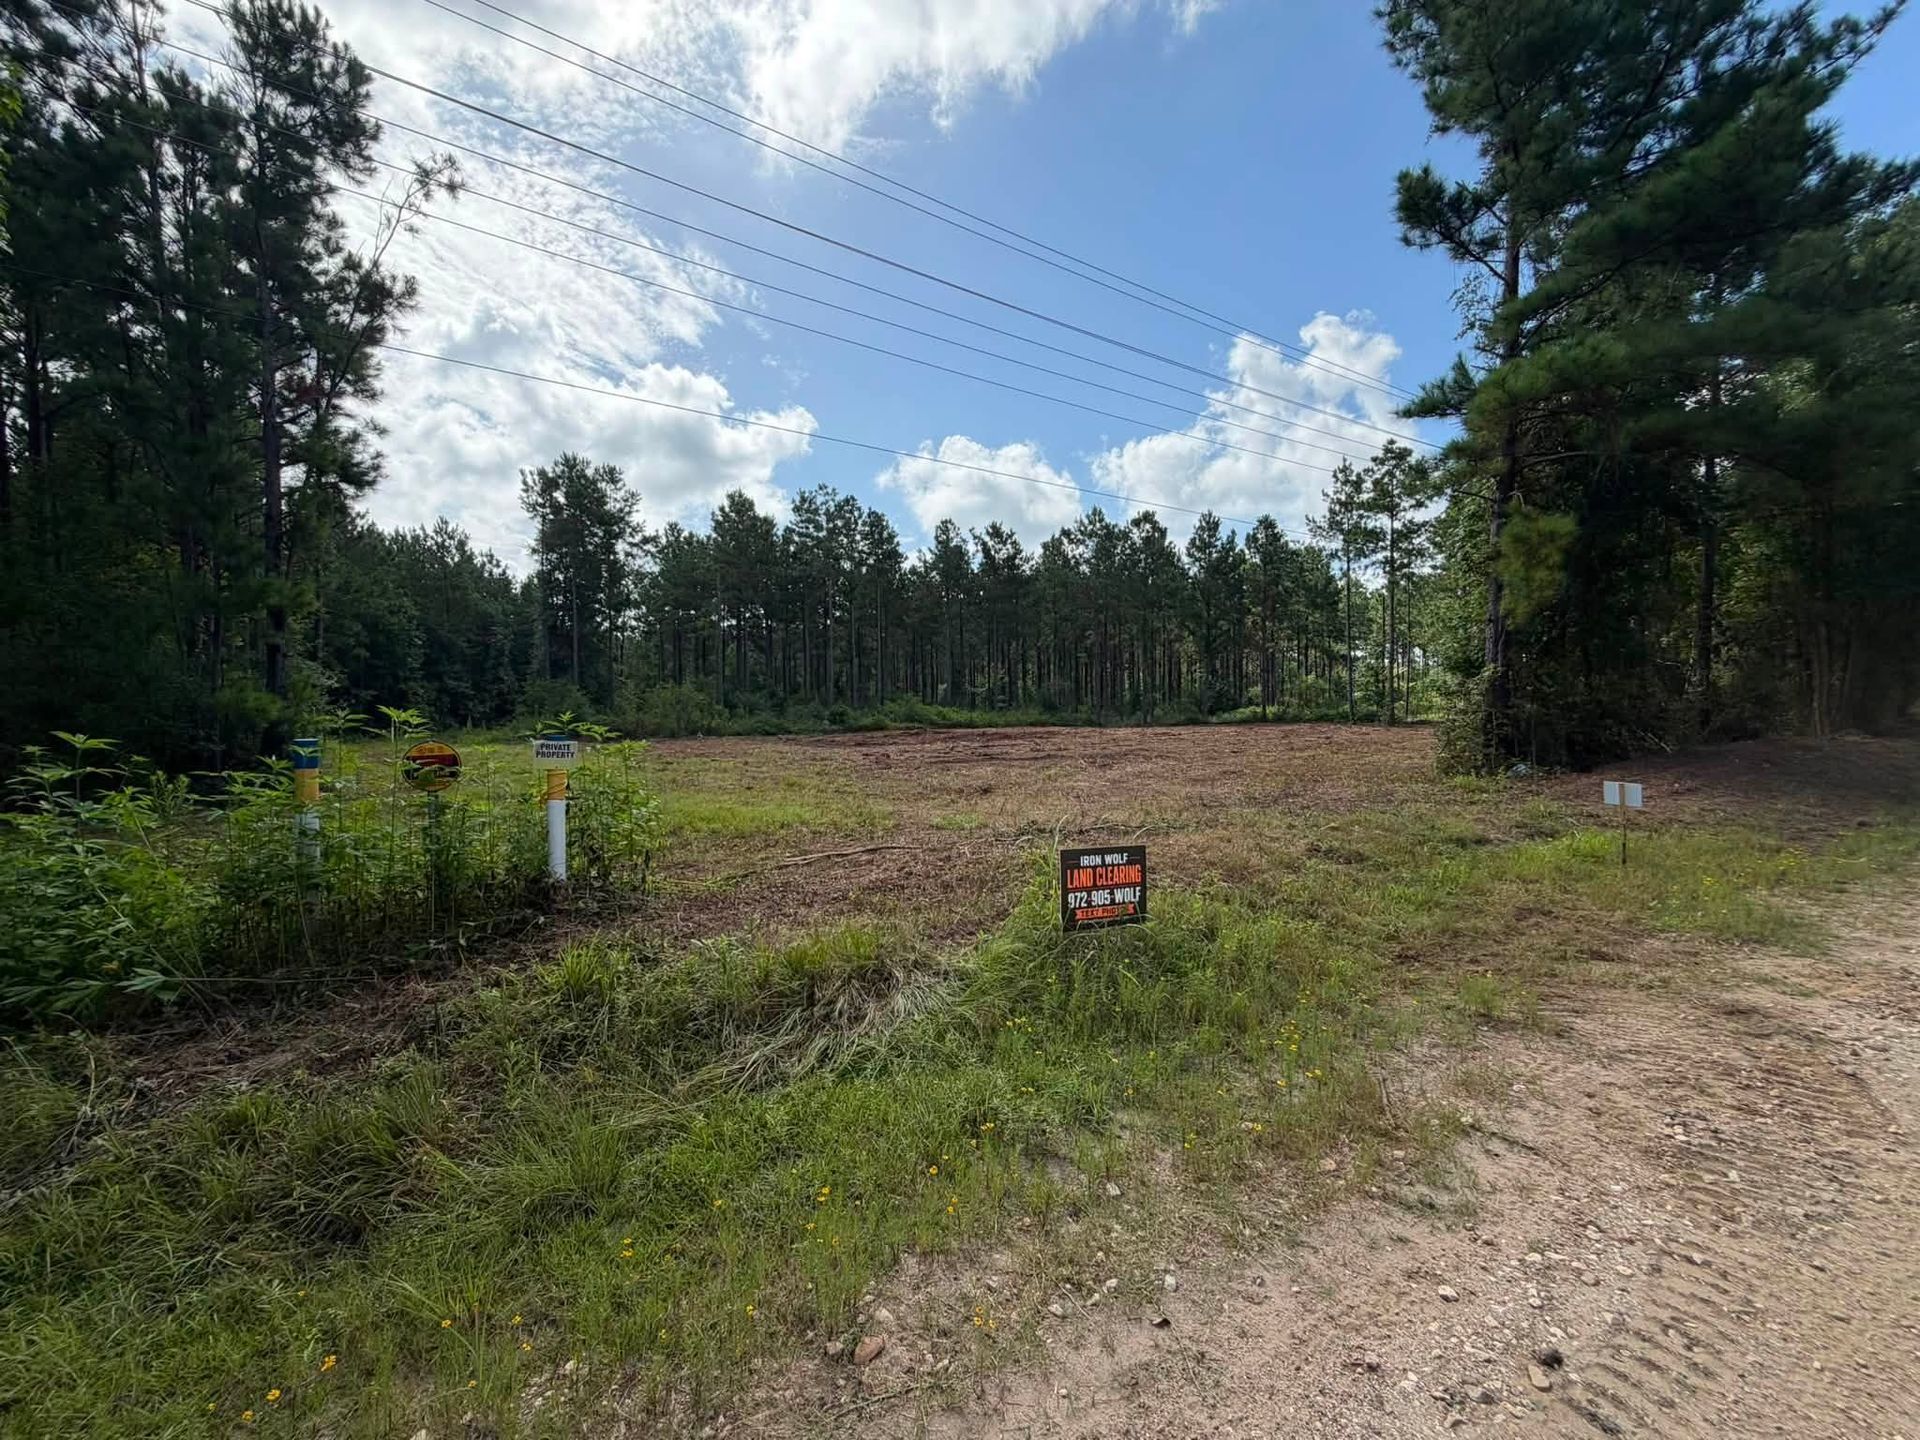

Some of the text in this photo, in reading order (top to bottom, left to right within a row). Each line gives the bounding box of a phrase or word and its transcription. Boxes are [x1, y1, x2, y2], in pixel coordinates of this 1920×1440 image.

[540, 743, 571, 751] PRIVATE
[535, 750, 575, 758] PROPERTY
[1080, 853, 1128, 866] IRON WOLF
[1067, 864, 1141, 888] LAND CLEARING
